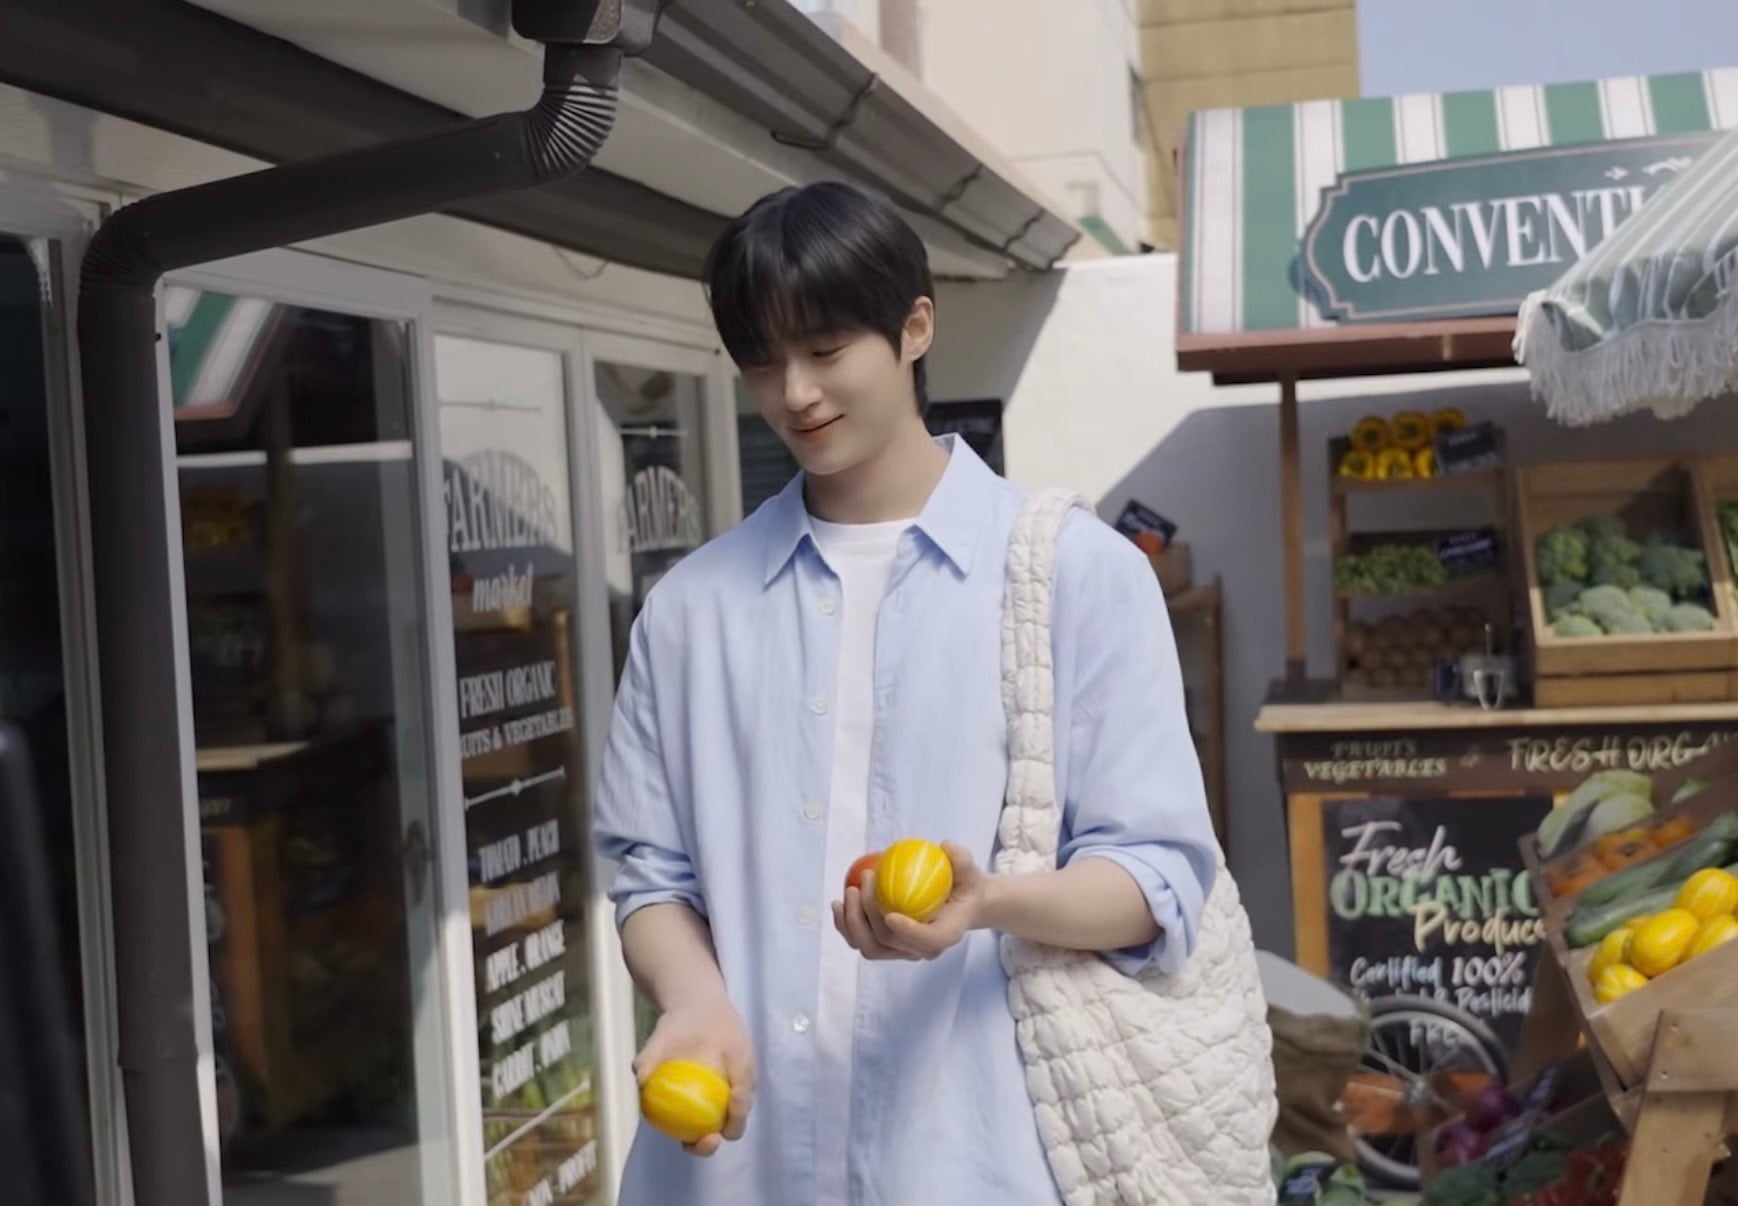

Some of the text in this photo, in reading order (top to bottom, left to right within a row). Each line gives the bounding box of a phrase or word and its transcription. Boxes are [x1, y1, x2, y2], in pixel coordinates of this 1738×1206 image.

[459, 670, 505, 719] FRESH
[1303, 757, 1447, 784] VEGETABLES
[1506, 735, 1622, 773] FRESH
[1339, 820, 1462, 882] Fresh
[1330, 867, 1540, 920] ORGANIC
[1350, 951, 1527, 990] Certified 100%
